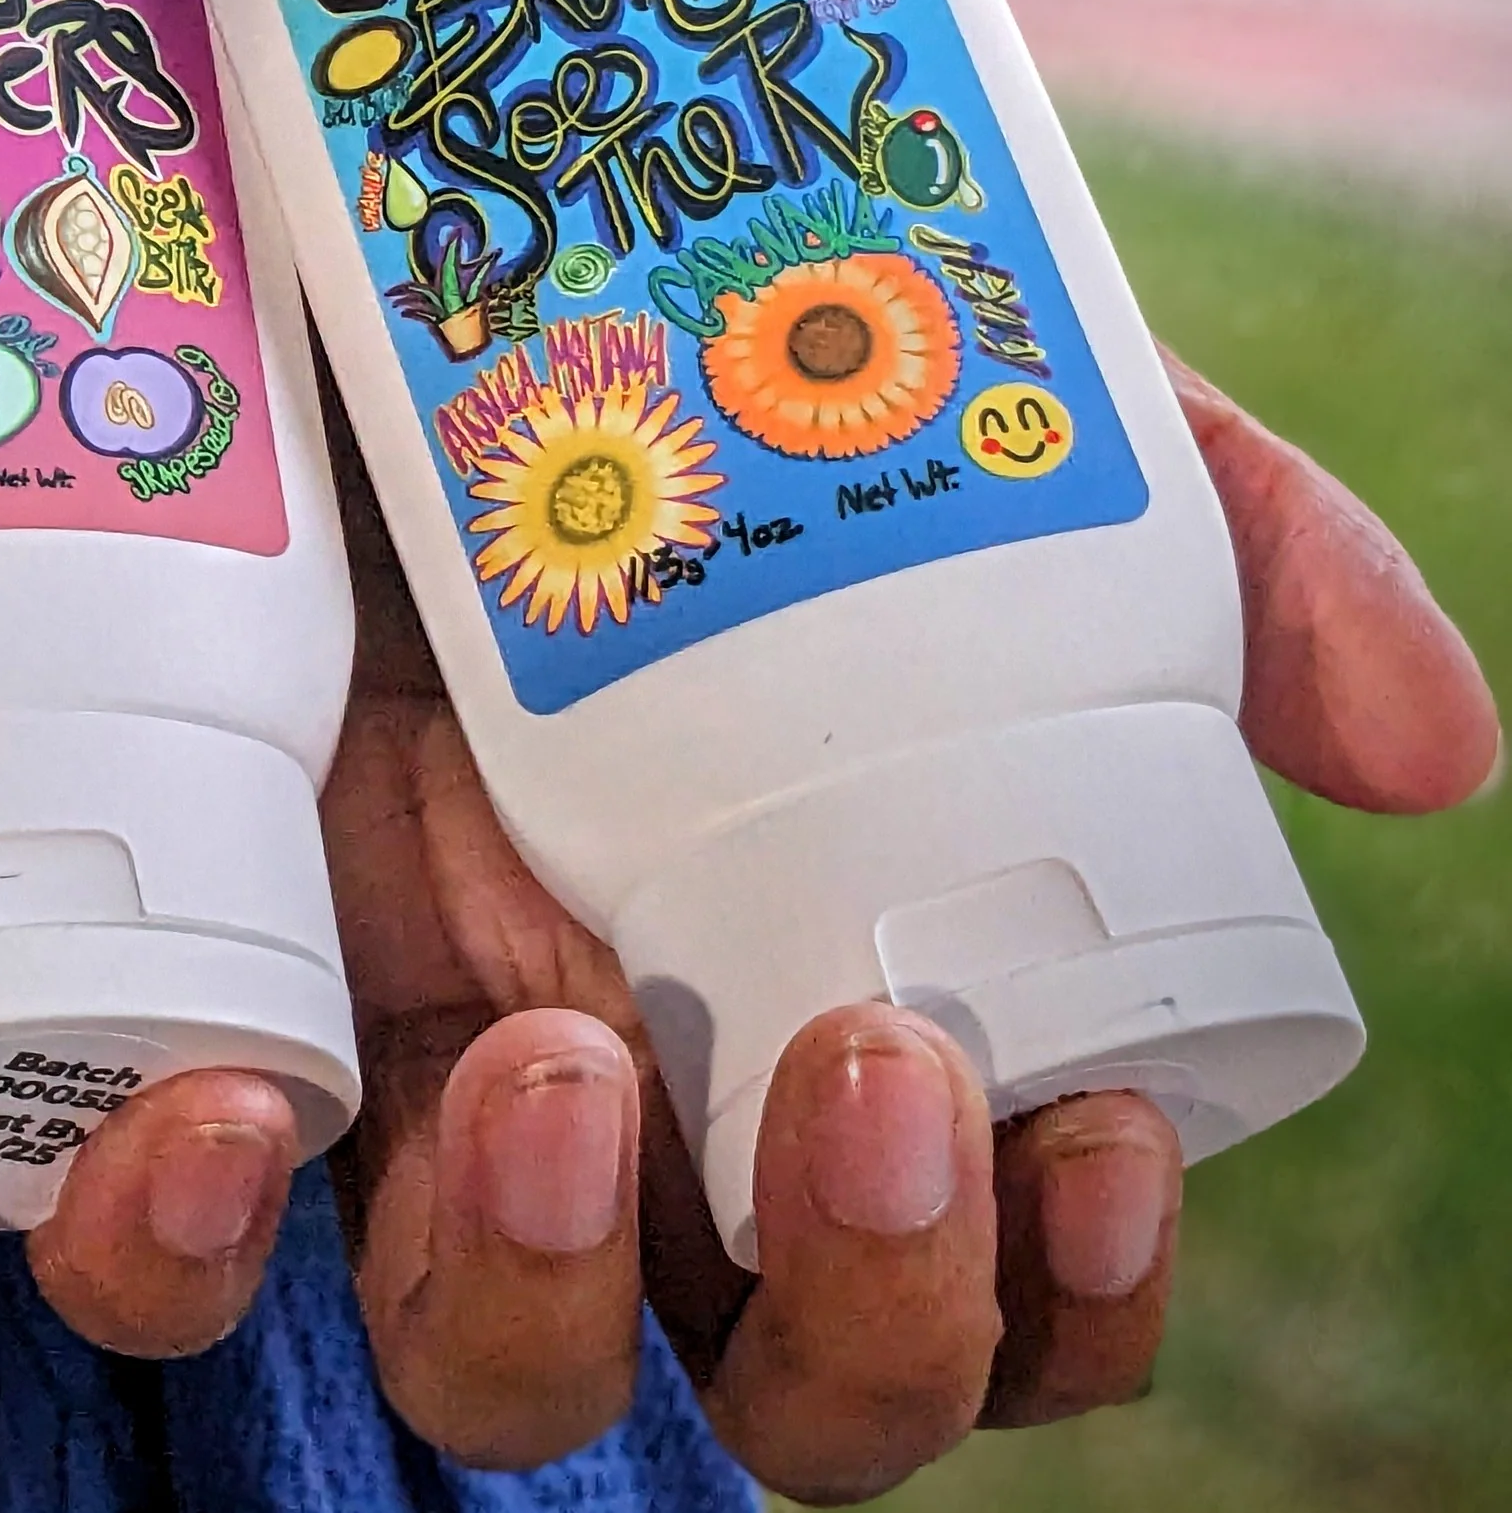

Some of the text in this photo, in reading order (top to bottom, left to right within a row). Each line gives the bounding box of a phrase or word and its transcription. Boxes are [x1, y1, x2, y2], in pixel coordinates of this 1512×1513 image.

[837, 471, 899, 521] Net
[3, 1051, 143, 1089] Batch
[36, 1117, 91, 1148] By
